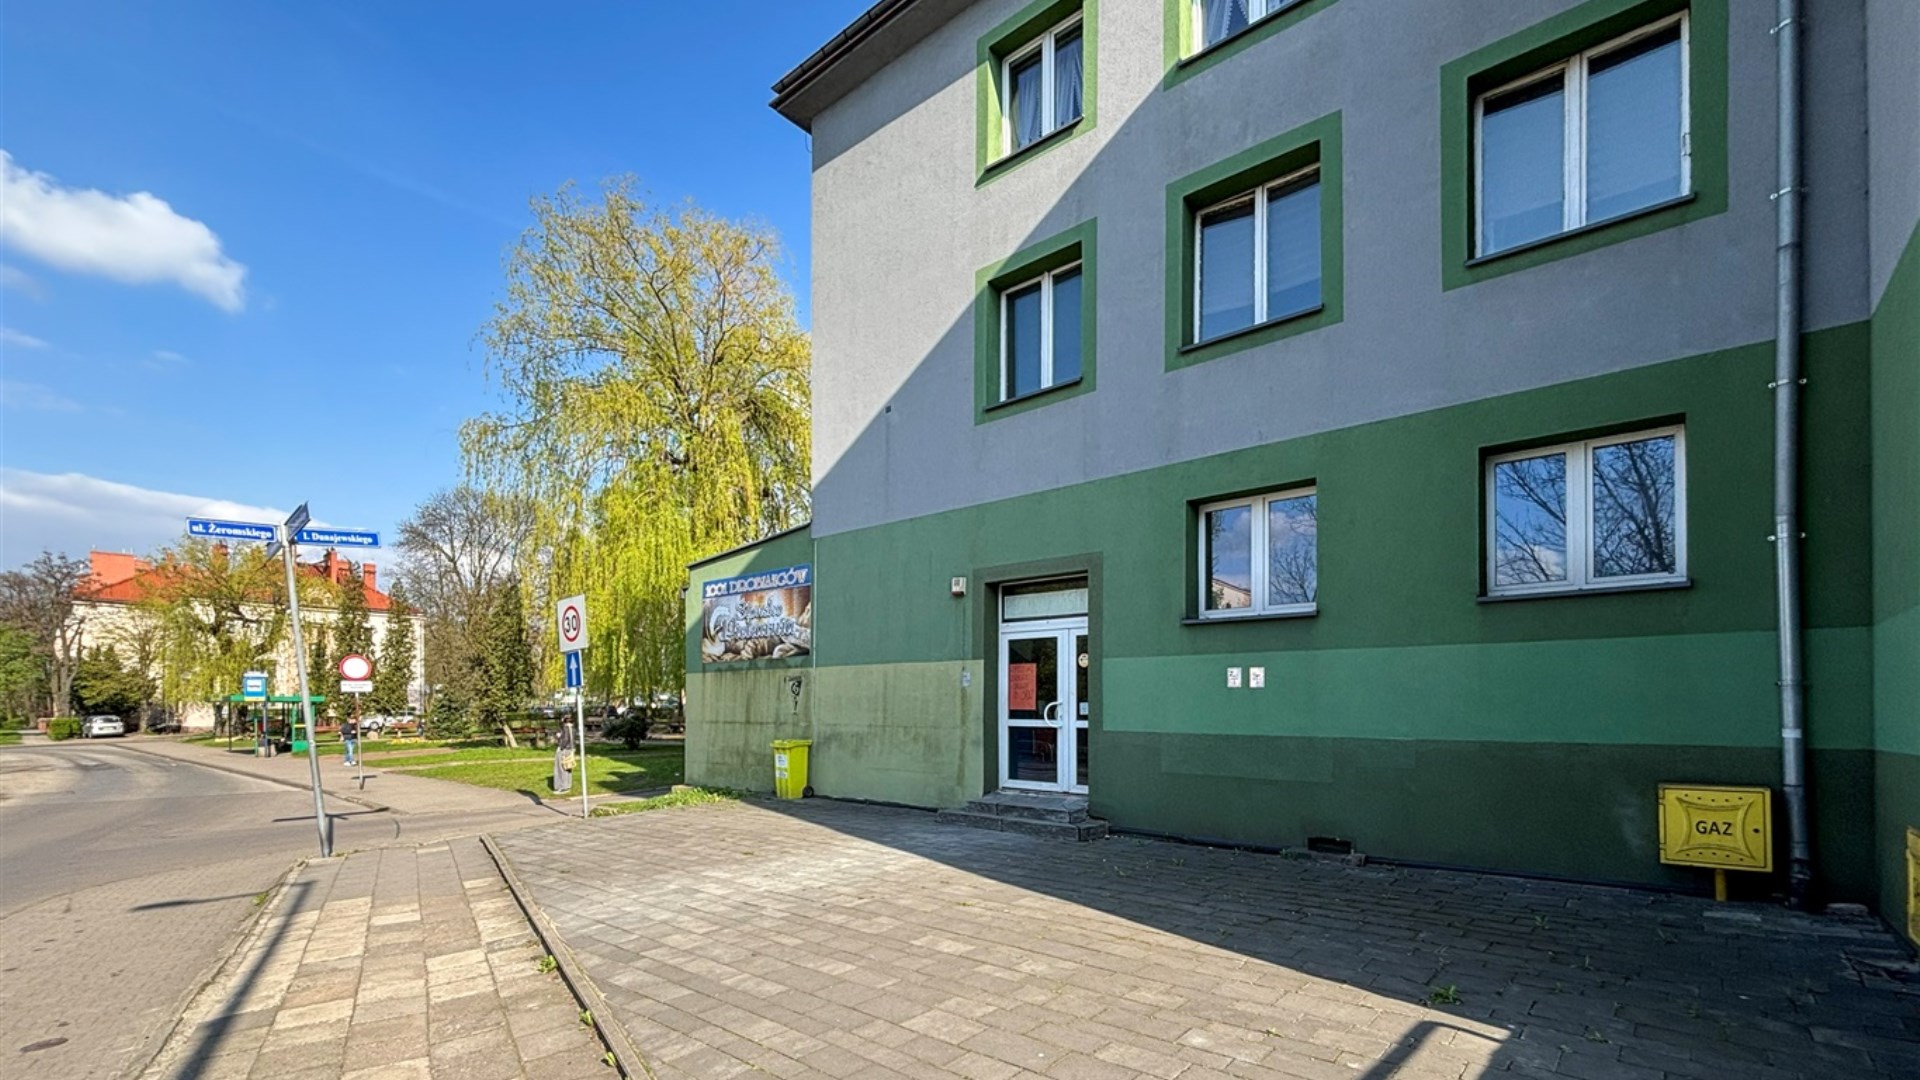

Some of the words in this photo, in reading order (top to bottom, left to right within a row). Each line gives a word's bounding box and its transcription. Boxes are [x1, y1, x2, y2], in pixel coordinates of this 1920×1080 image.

[191, 523, 206, 533] ul.
[208, 521, 273, 539] Żeromskiego
[311, 532, 373, 545] Dunajewskiego
[705, 582, 728, 598] 1001
[565, 614, 578, 633] 30
[1695, 820, 1733, 836] GAZ
